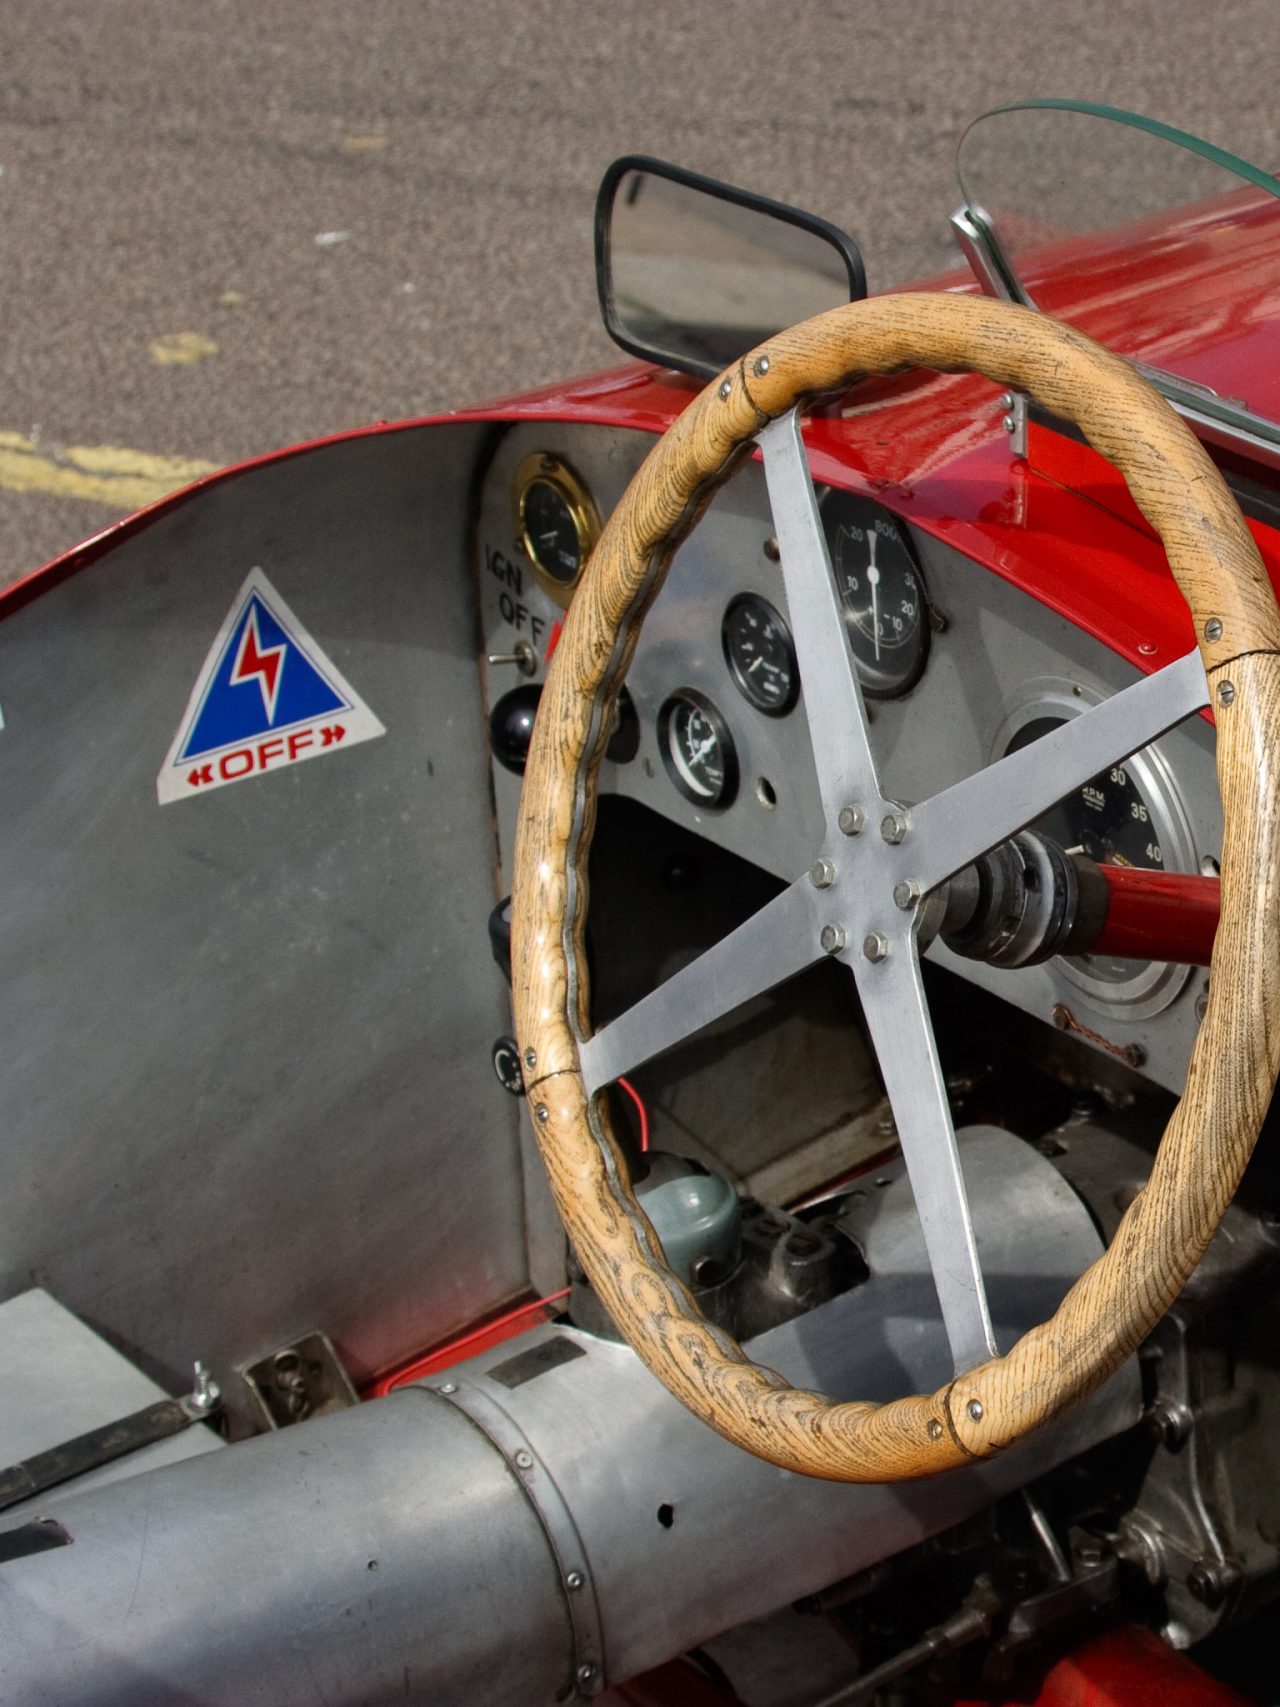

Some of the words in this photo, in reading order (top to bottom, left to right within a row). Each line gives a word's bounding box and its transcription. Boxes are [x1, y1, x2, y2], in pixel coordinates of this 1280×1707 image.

[850, 526, 864, 542] 20
[486, 543, 523, 597] IGN
[847, 575, 859, 591] 10
[901, 600, 914, 616] 20
[499, 592, 545, 647] OFF
[892, 616, 903, 632] 10
[219, 729, 314, 781] OFF
[1110, 767, 1126, 786] 30
[1131, 802, 1148, 822] 35
[1146, 842, 1162, 862] 40
